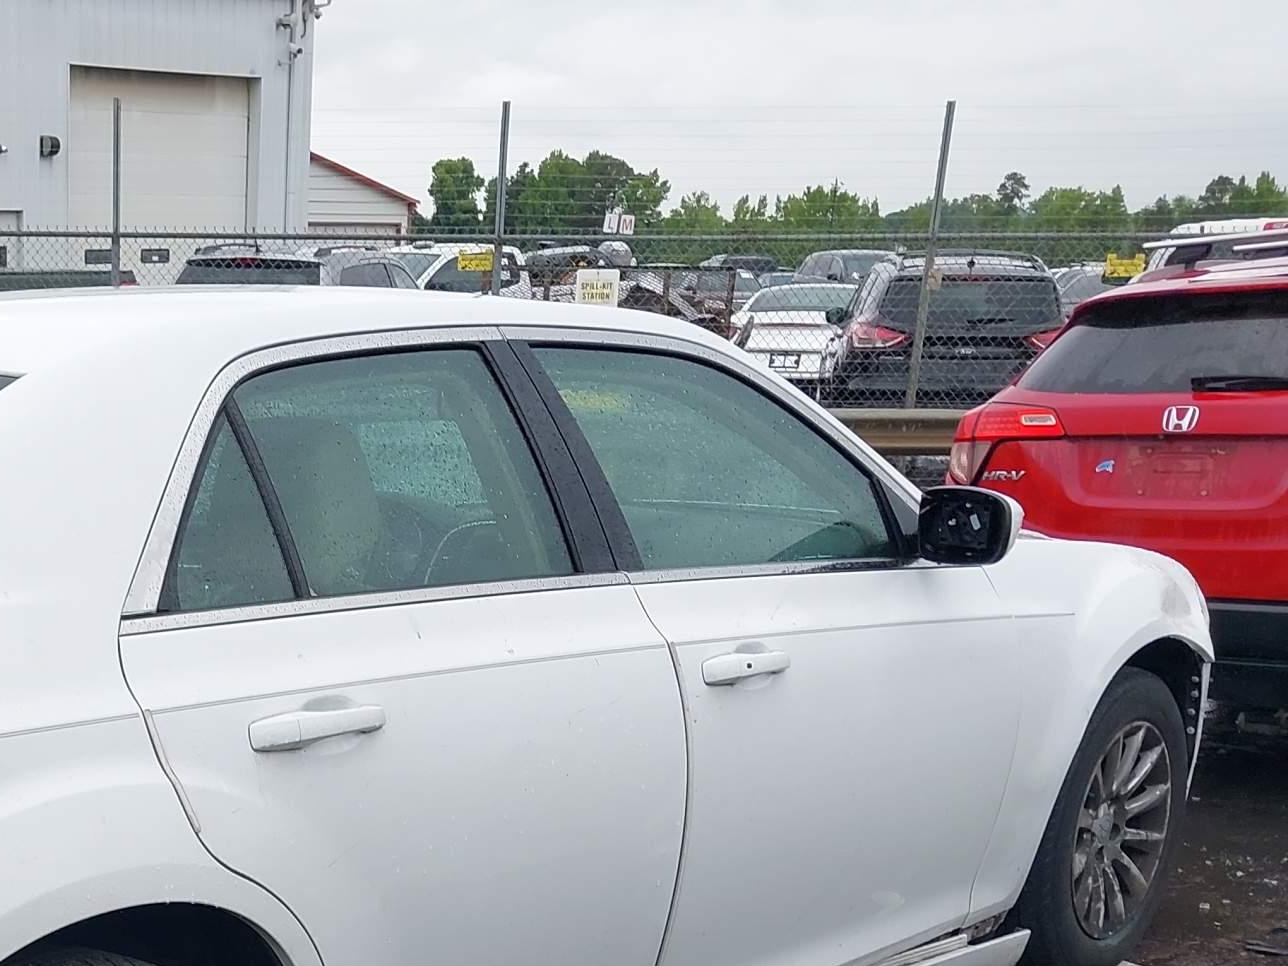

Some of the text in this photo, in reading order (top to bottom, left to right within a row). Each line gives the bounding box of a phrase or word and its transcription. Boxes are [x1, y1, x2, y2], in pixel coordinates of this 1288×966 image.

[622, 218, 633, 231] M
[582, 291, 610, 300] STATION
[982, 470, 1026, 481] HR-V
